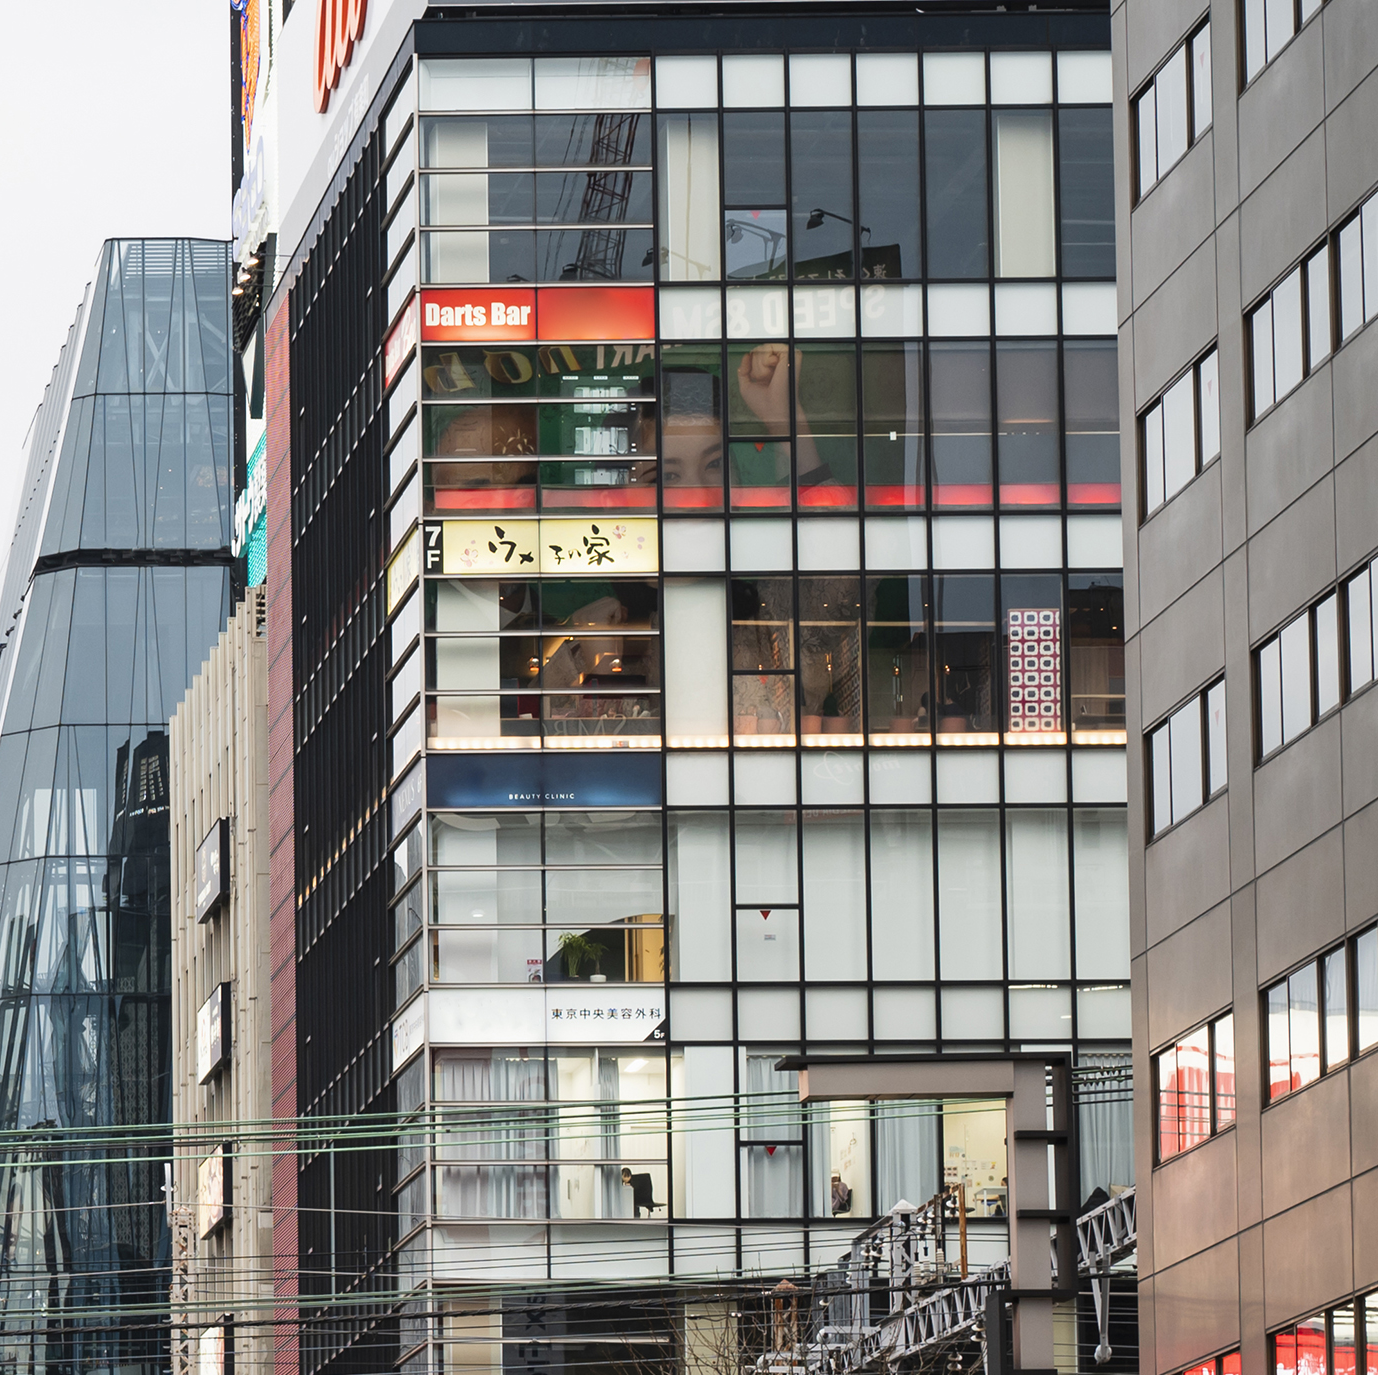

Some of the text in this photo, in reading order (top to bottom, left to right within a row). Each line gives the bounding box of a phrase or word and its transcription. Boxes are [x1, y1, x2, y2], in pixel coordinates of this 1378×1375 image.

[425, 302, 531, 327] Darts Bar
[544, 792, 575, 800] CLINIC
[551, 1008, 661, 1020] 東京中央美容外科
[653, 1029, 665, 1039] 5F
